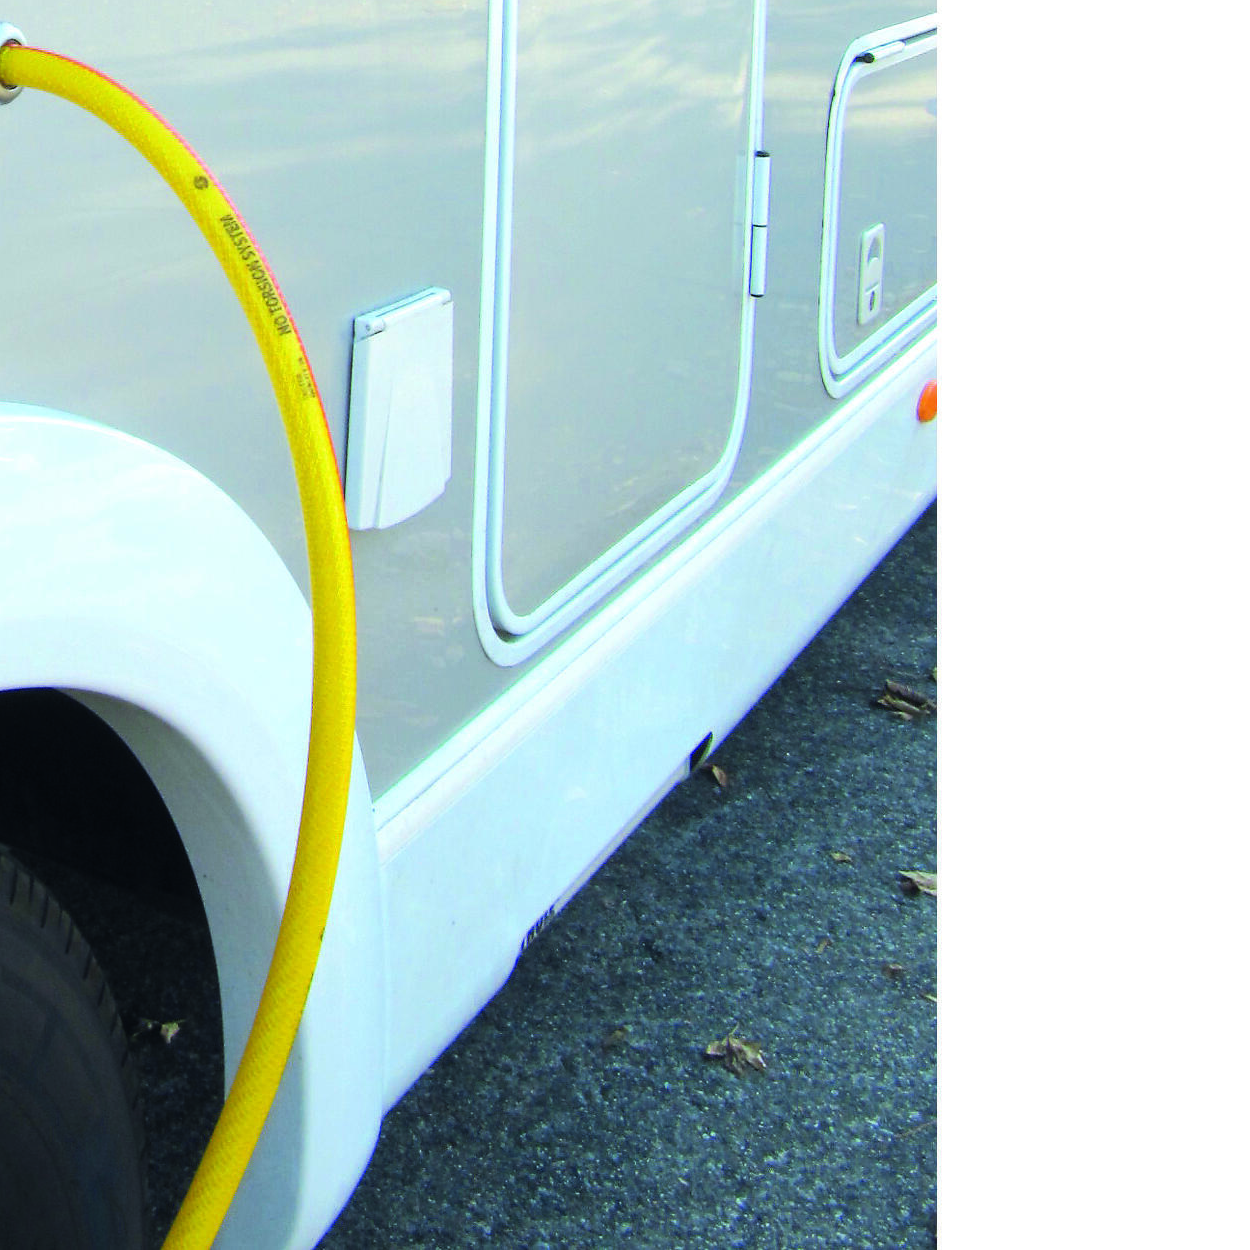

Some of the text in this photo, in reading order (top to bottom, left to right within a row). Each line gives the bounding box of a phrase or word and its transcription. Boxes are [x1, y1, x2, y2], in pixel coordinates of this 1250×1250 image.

[220, 214, 291, 336] NO TORSION SYSTEM
